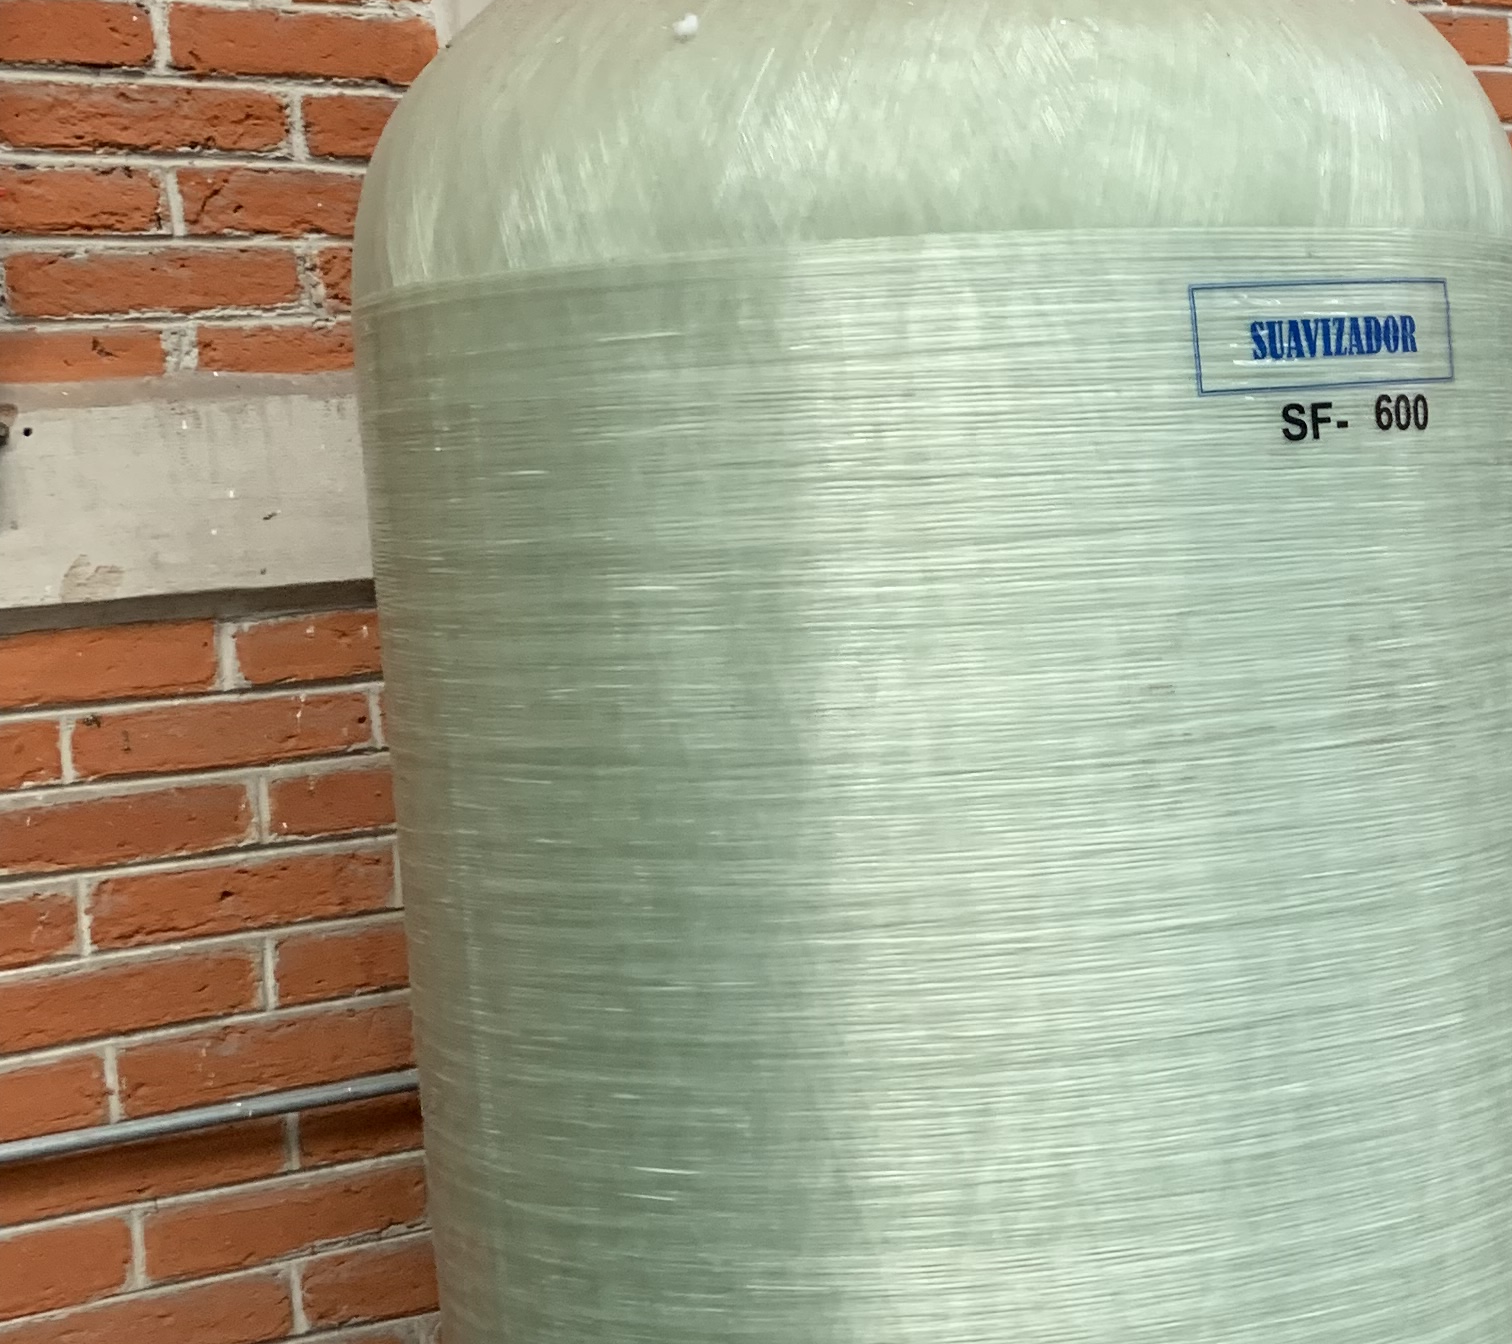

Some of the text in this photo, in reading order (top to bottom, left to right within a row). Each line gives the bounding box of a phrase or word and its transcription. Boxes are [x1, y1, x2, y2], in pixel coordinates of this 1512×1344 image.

[1250, 314, 1418, 360] SUAVIZADOR
[1281, 393, 1429, 442] SF- 600
